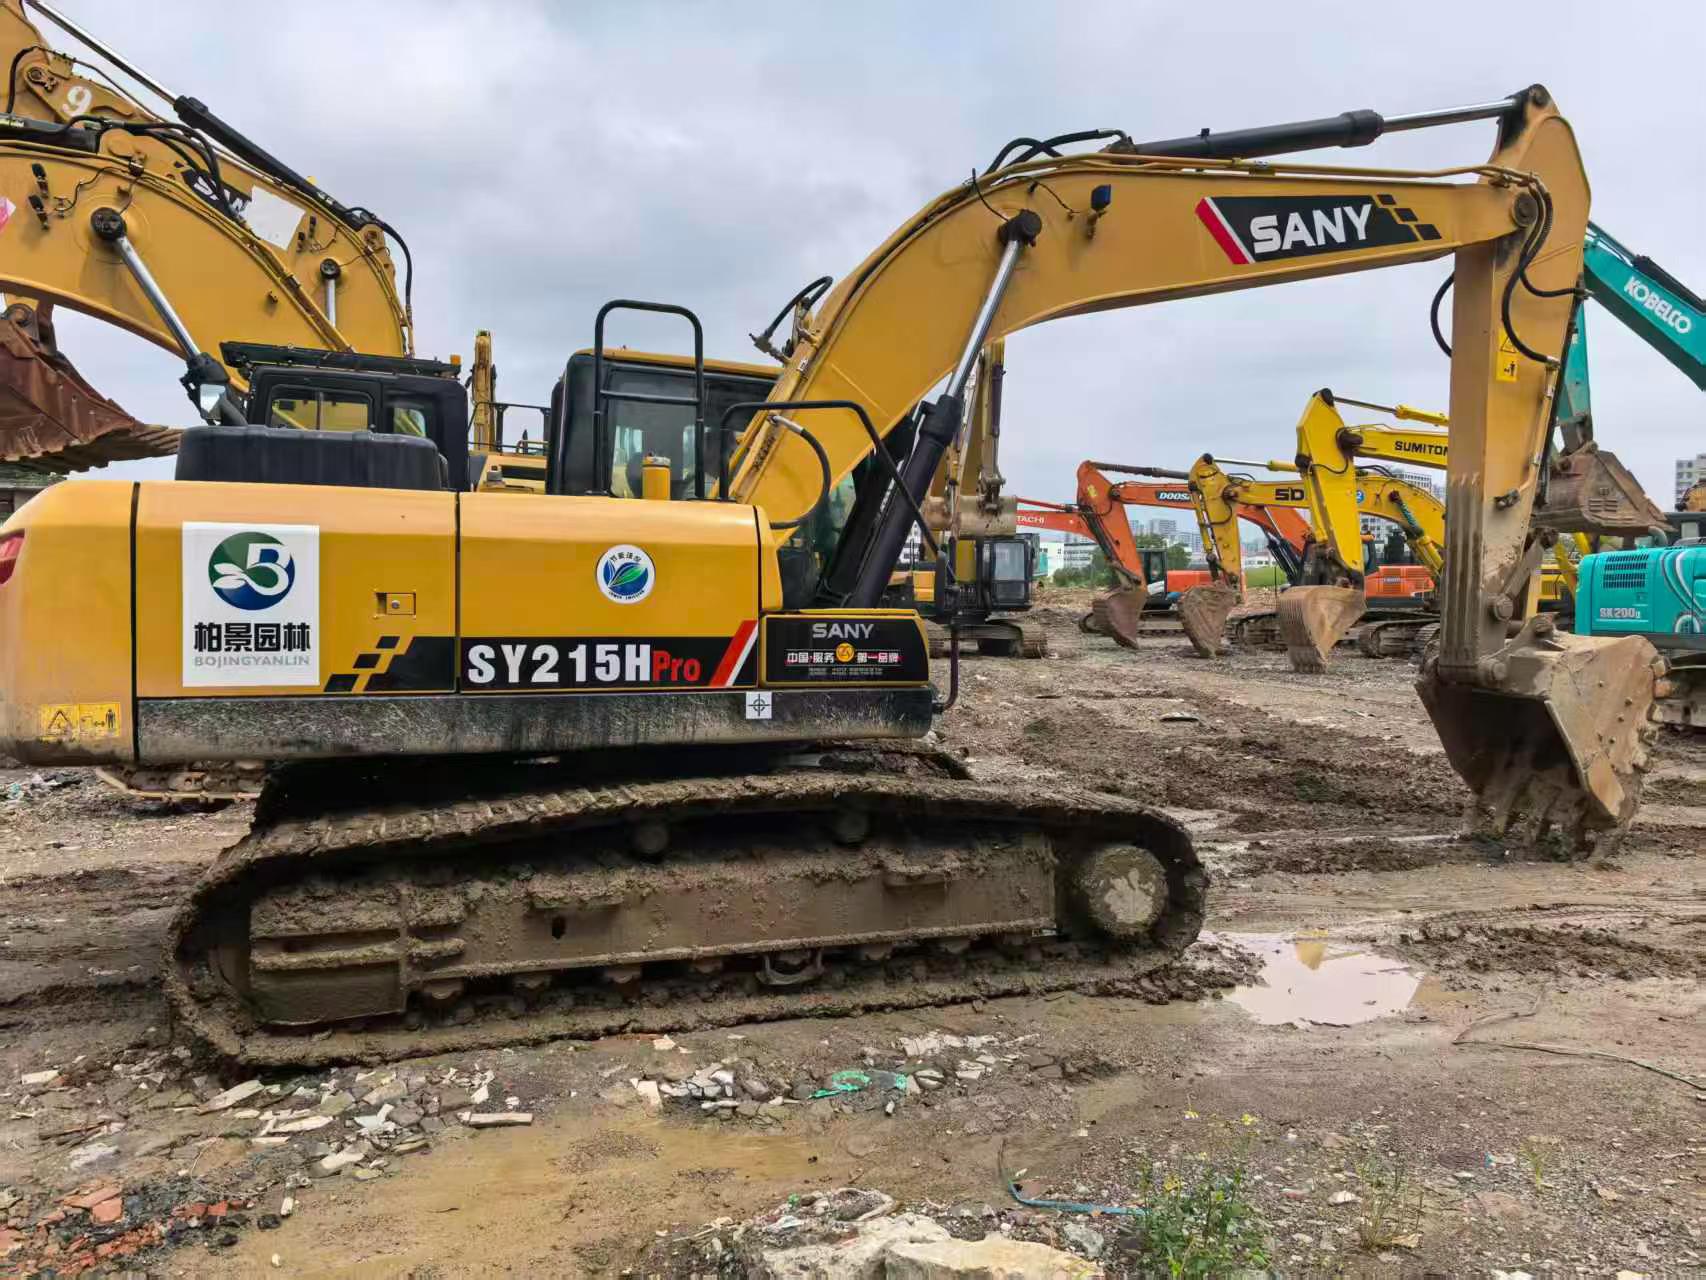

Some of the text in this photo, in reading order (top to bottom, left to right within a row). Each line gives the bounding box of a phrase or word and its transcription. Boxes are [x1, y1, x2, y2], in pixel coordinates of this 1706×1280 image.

[63, 86, 92, 117] 9
[1250, 204, 1372, 254] SANY
[1624, 276, 1692, 333] KOBELCO
[194, 622, 311, 652] 柏景园林
[812, 623, 874, 638] SANY
[194, 655, 311, 668] BOJINGYANLIN
